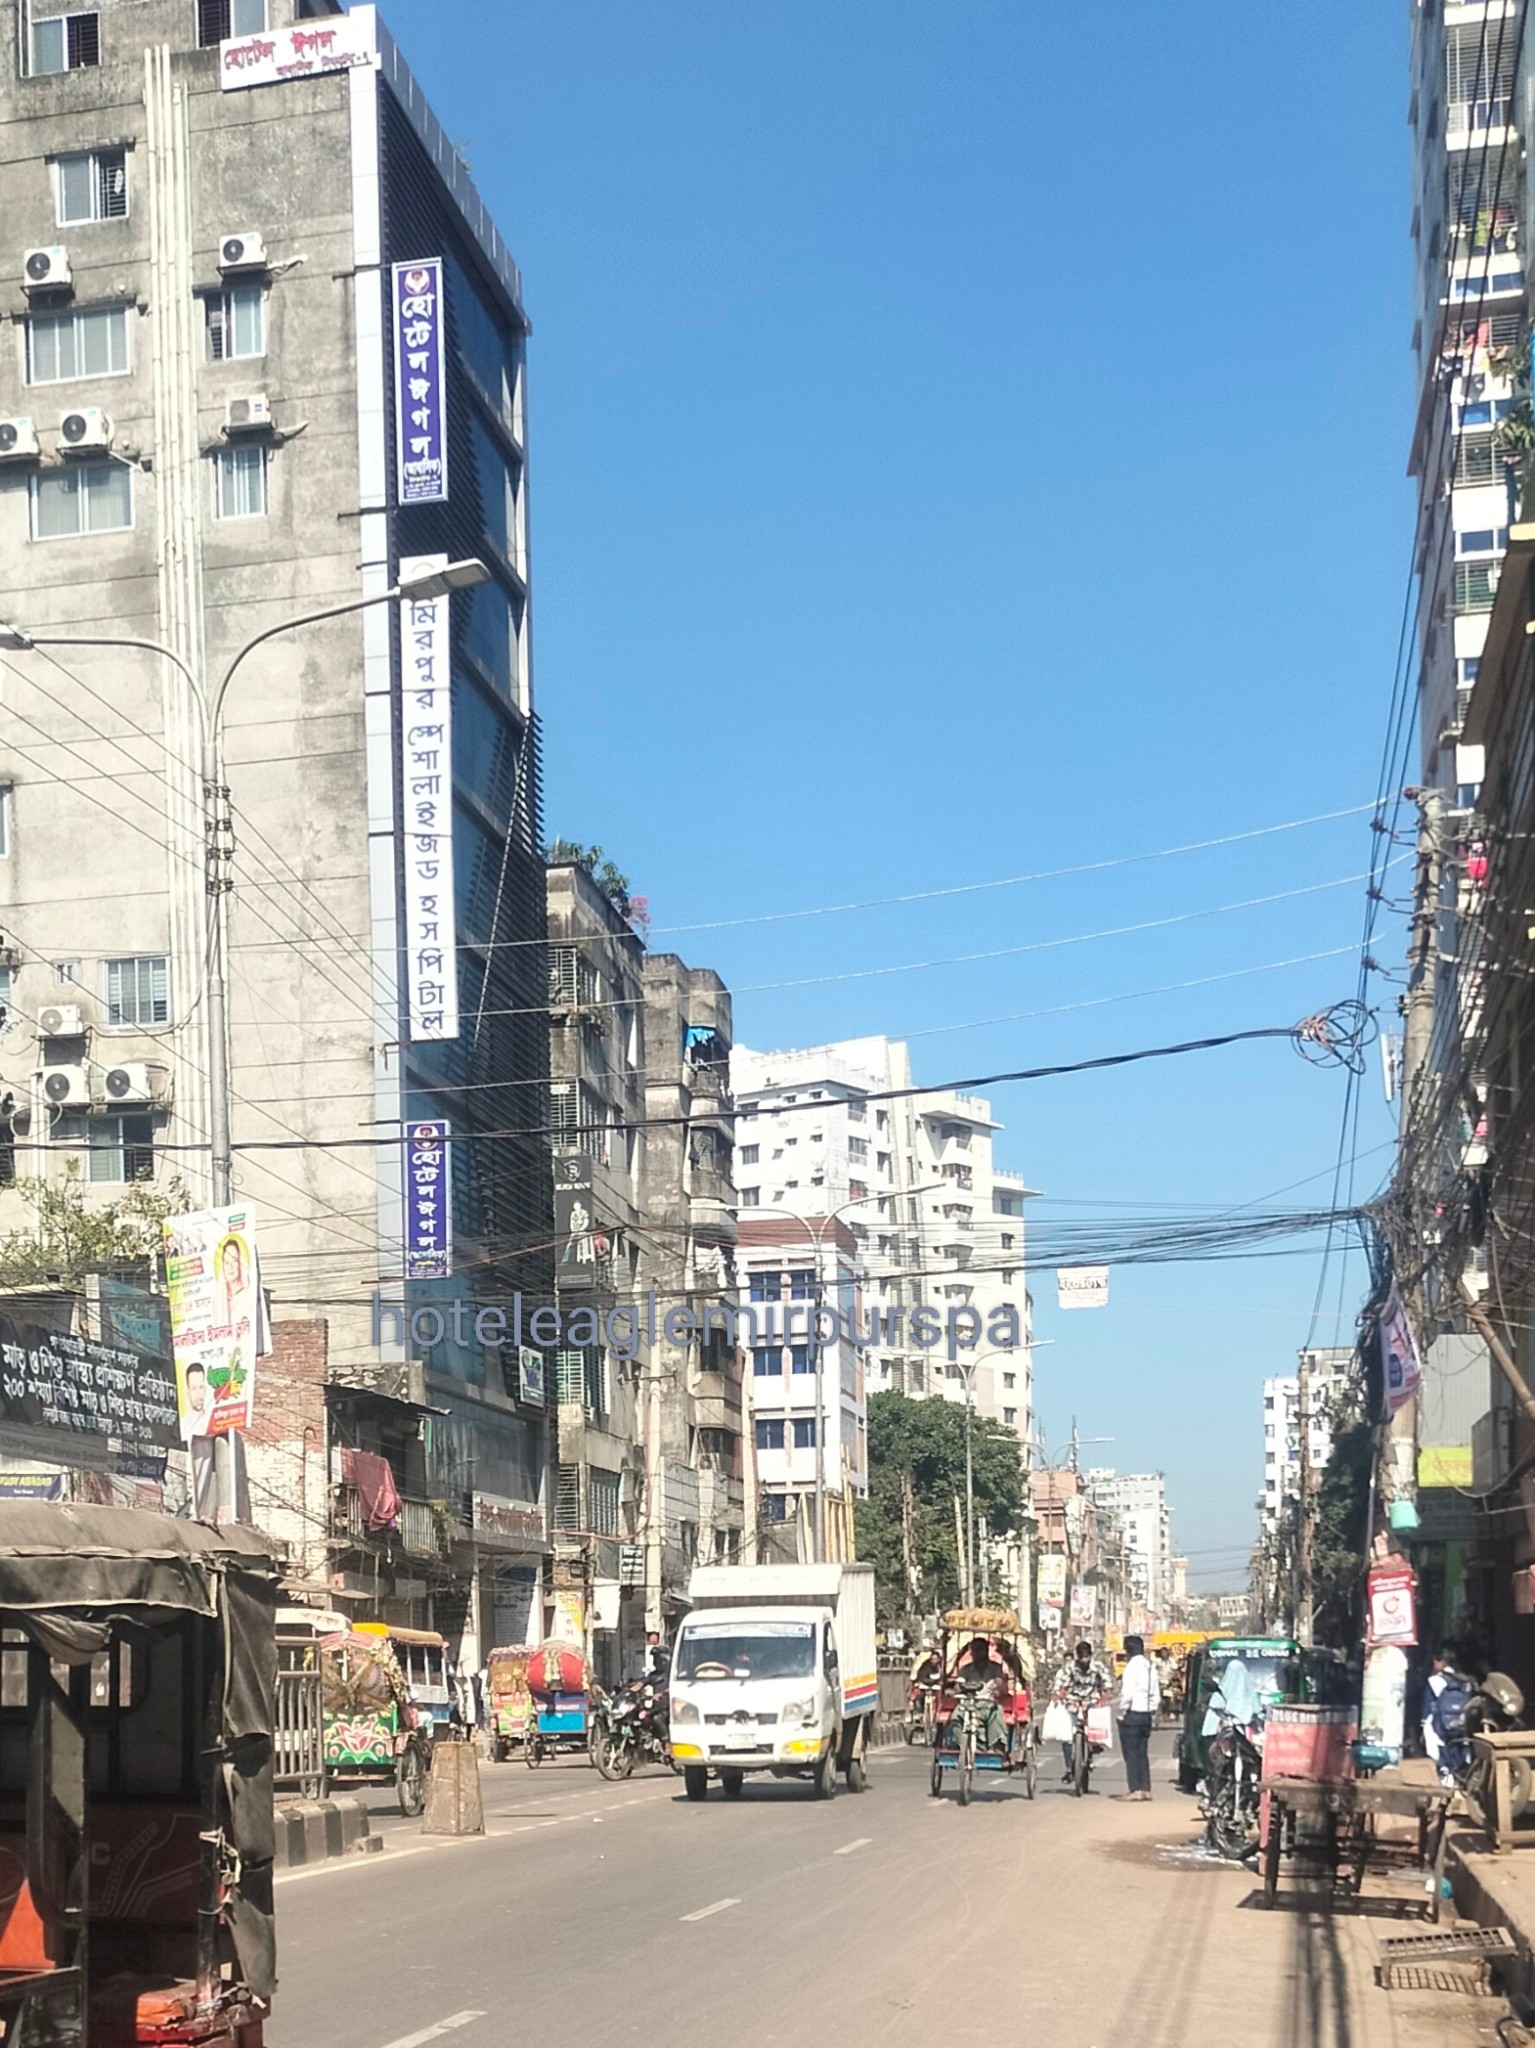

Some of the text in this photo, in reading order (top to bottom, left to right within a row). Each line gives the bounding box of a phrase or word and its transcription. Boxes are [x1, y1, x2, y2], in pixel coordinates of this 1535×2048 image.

[224, 30, 336, 70] হোটেল ঈগল
[402, 292, 435, 373] হোটেল
[408, 377, 432, 458] ঈগল
[416, 894, 446, 1031] হসপিটাল
[412, 1150, 443, 1199] হোটেল
[416, 1200, 438, 1251] ঈগল
[1, 1341, 26, 1378] মাতৃ
[28, 1350, 40, 1375] ও
[39, 1345, 63, 1379] শিশু
[65, 1357, 93, 1387] স্বাস্থ্য
[3, 1373, 25, 1399] ২০০
[79, 1387, 98, 1415] মাতৃ
[107, 1389, 125, 1417] শিশু
